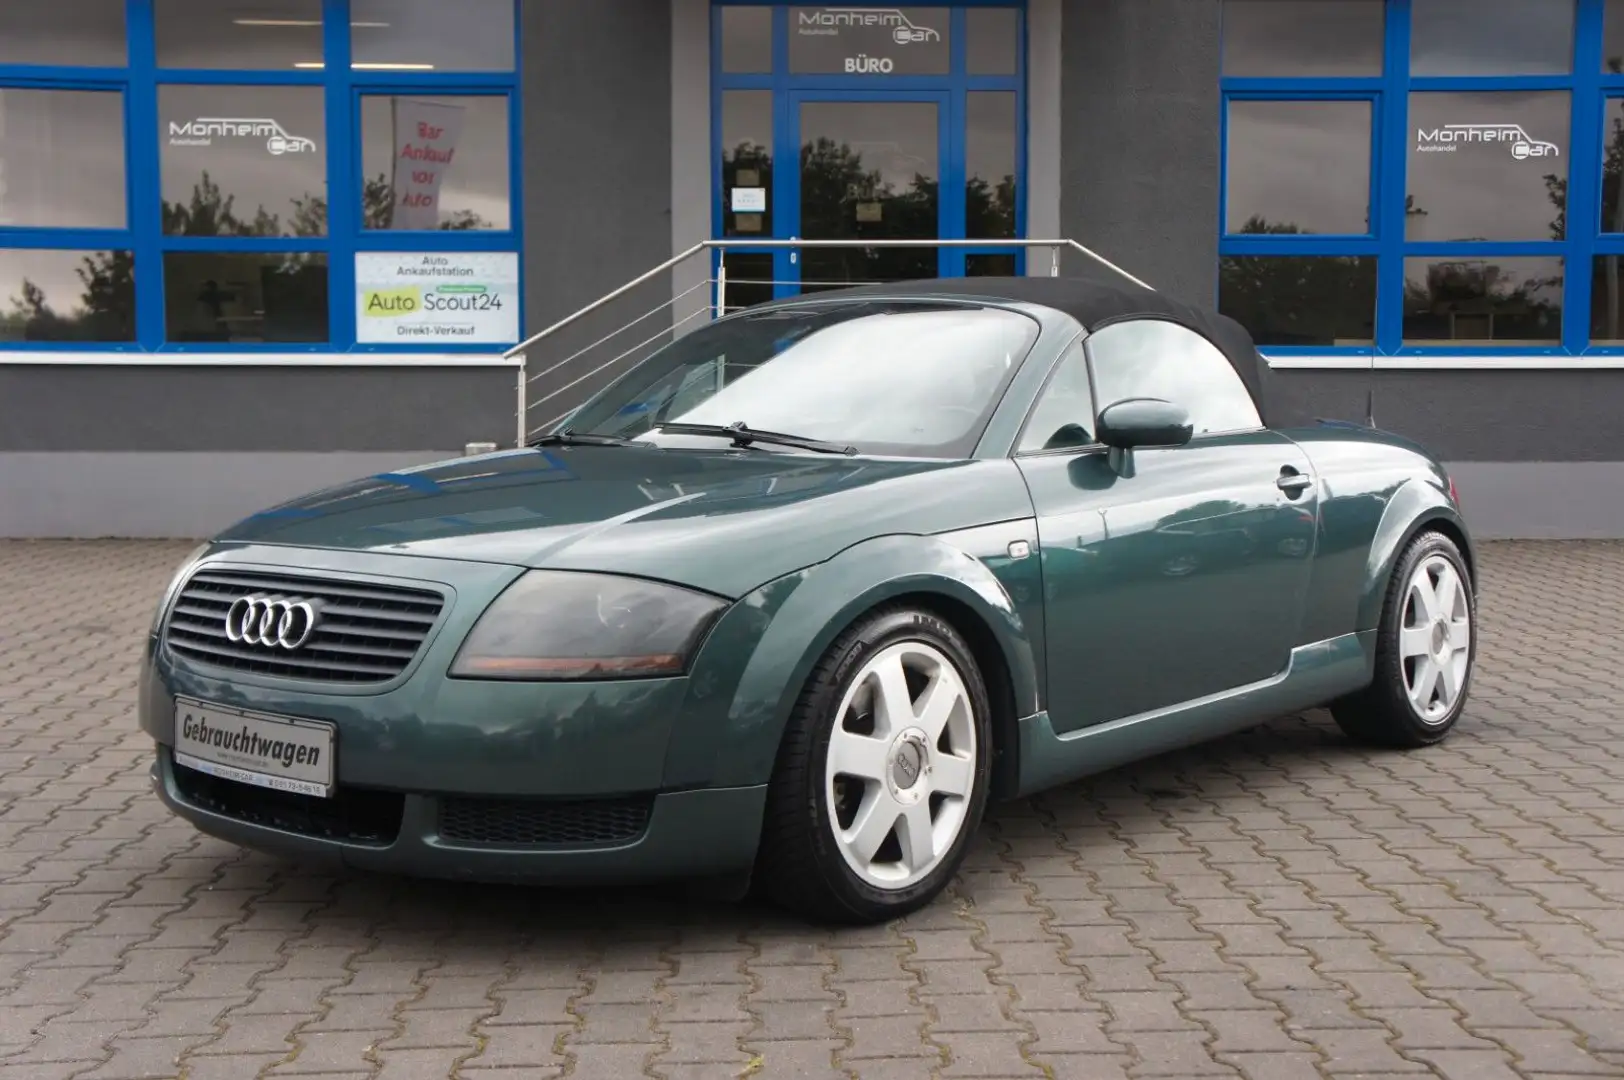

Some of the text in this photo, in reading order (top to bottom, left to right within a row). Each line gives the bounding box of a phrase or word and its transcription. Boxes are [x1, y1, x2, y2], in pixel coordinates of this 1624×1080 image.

[798, 11, 901, 26] Monheim
[844, 53, 893, 74] BÜRO
[169, 120, 276, 136] Monheim
[1417, 127, 1521, 142] Monheim
[1416, 144, 1457, 152] Autohandel
[422, 256, 449, 266] Auto
[396, 266, 475, 277] Ankaufstation
[367, 293, 503, 311] Auto Scout24
[396, 325, 475, 336] Direkt-Verkauf
[182, 713, 321, 769] Gebrauchtwagen
